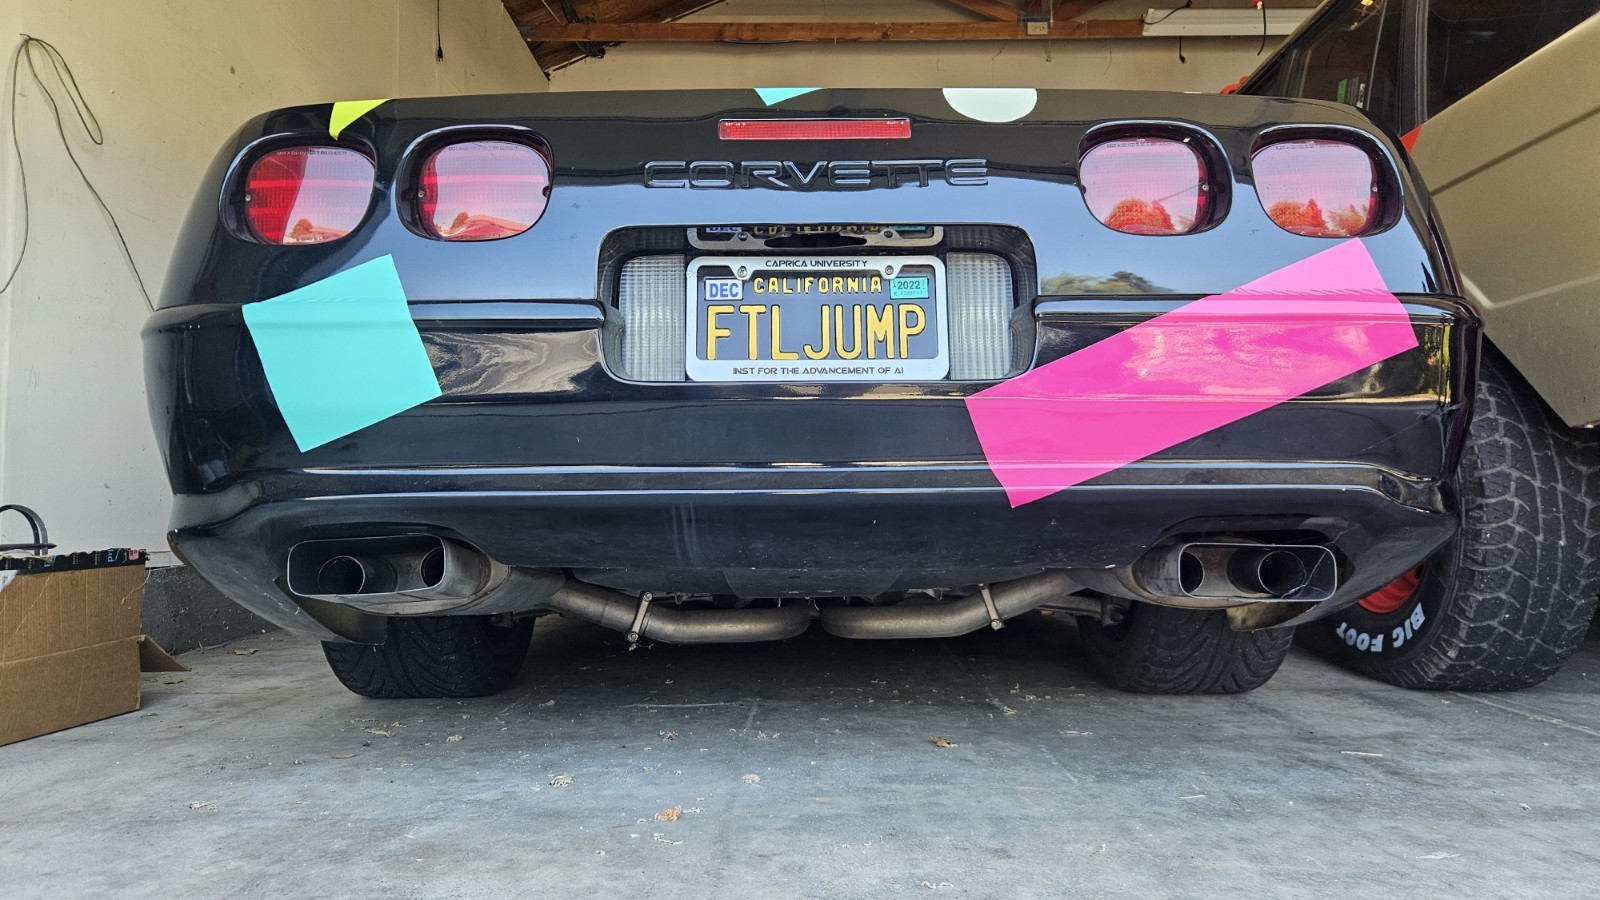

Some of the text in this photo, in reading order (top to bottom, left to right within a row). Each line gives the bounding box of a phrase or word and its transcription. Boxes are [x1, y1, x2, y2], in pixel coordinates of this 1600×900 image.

[644, 159, 988, 189] CORVETTE
[765, 260, 868, 268] CAPRICA UNIVERSITY
[708, 282, 740, 298] DEC
[753, 276, 883, 295] CALIFORNIA
[897, 280, 921, 290] 2022
[732, 367, 755, 375] INST
[757, 367, 778, 375] FOR
[780, 367, 800, 375] THE
[802, 367, 875, 375] ADVANCEMENT
[877, 366, 891, 374] OF
[1336, 602, 1425, 652] BIG FOOT
